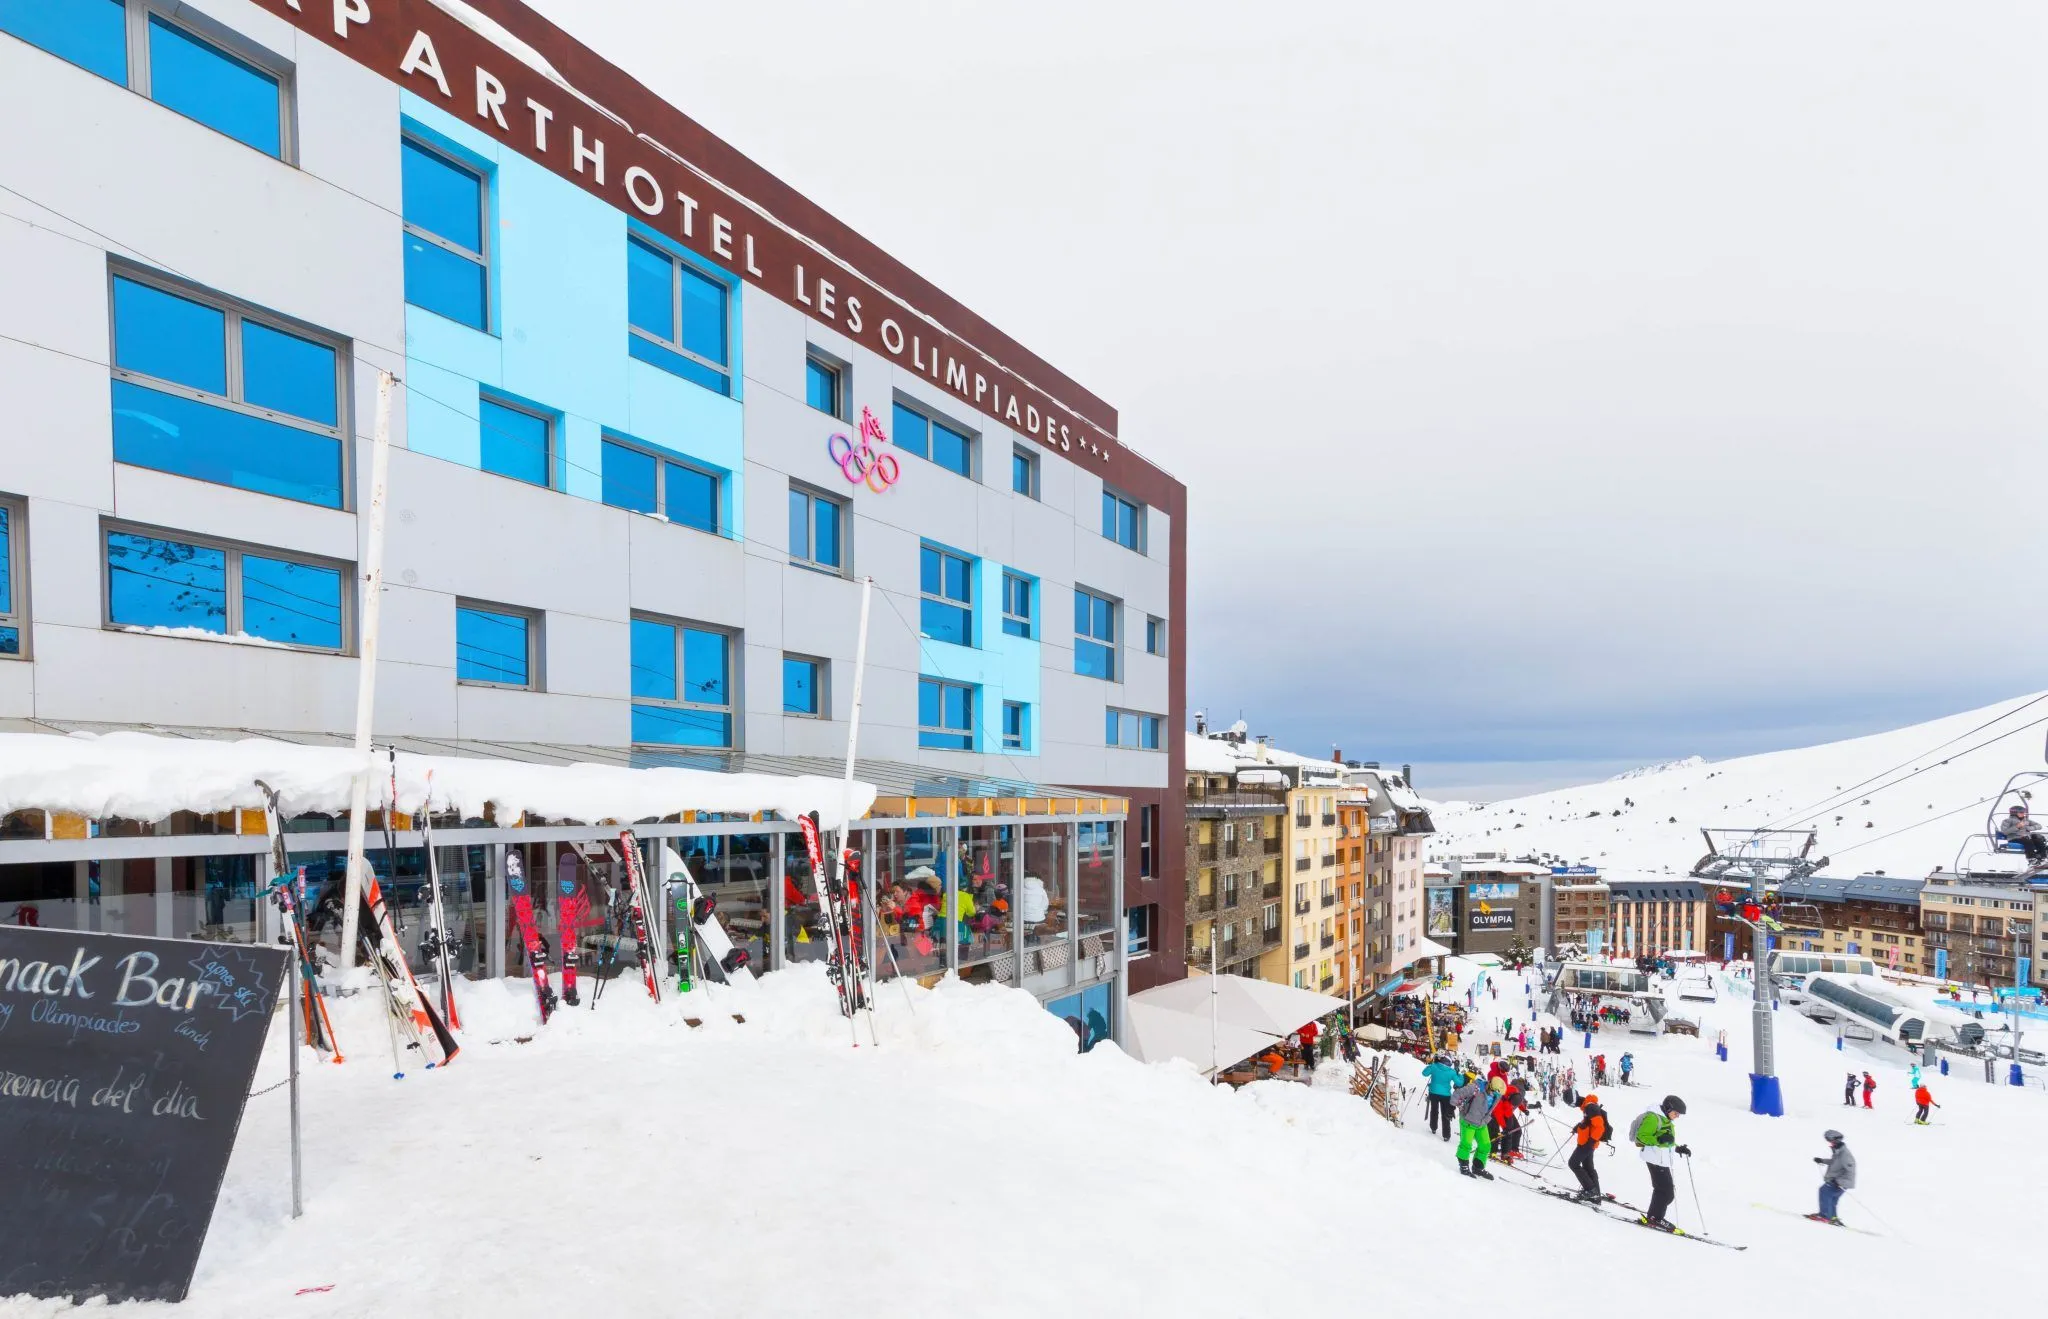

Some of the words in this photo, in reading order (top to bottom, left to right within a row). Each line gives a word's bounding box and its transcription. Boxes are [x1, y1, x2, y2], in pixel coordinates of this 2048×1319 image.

[286, 0, 763, 278] PARTHOTEL
[794, 264, 863, 333] LES
[881, 319, 1070, 453] OLIMPIADES
[1473, 916, 1513, 924] OLYMPIA
[112, 950, 212, 1013] Bar
[31, 999, 140, 1046] Olimpiades
[91, 1065, 147, 1113] del
